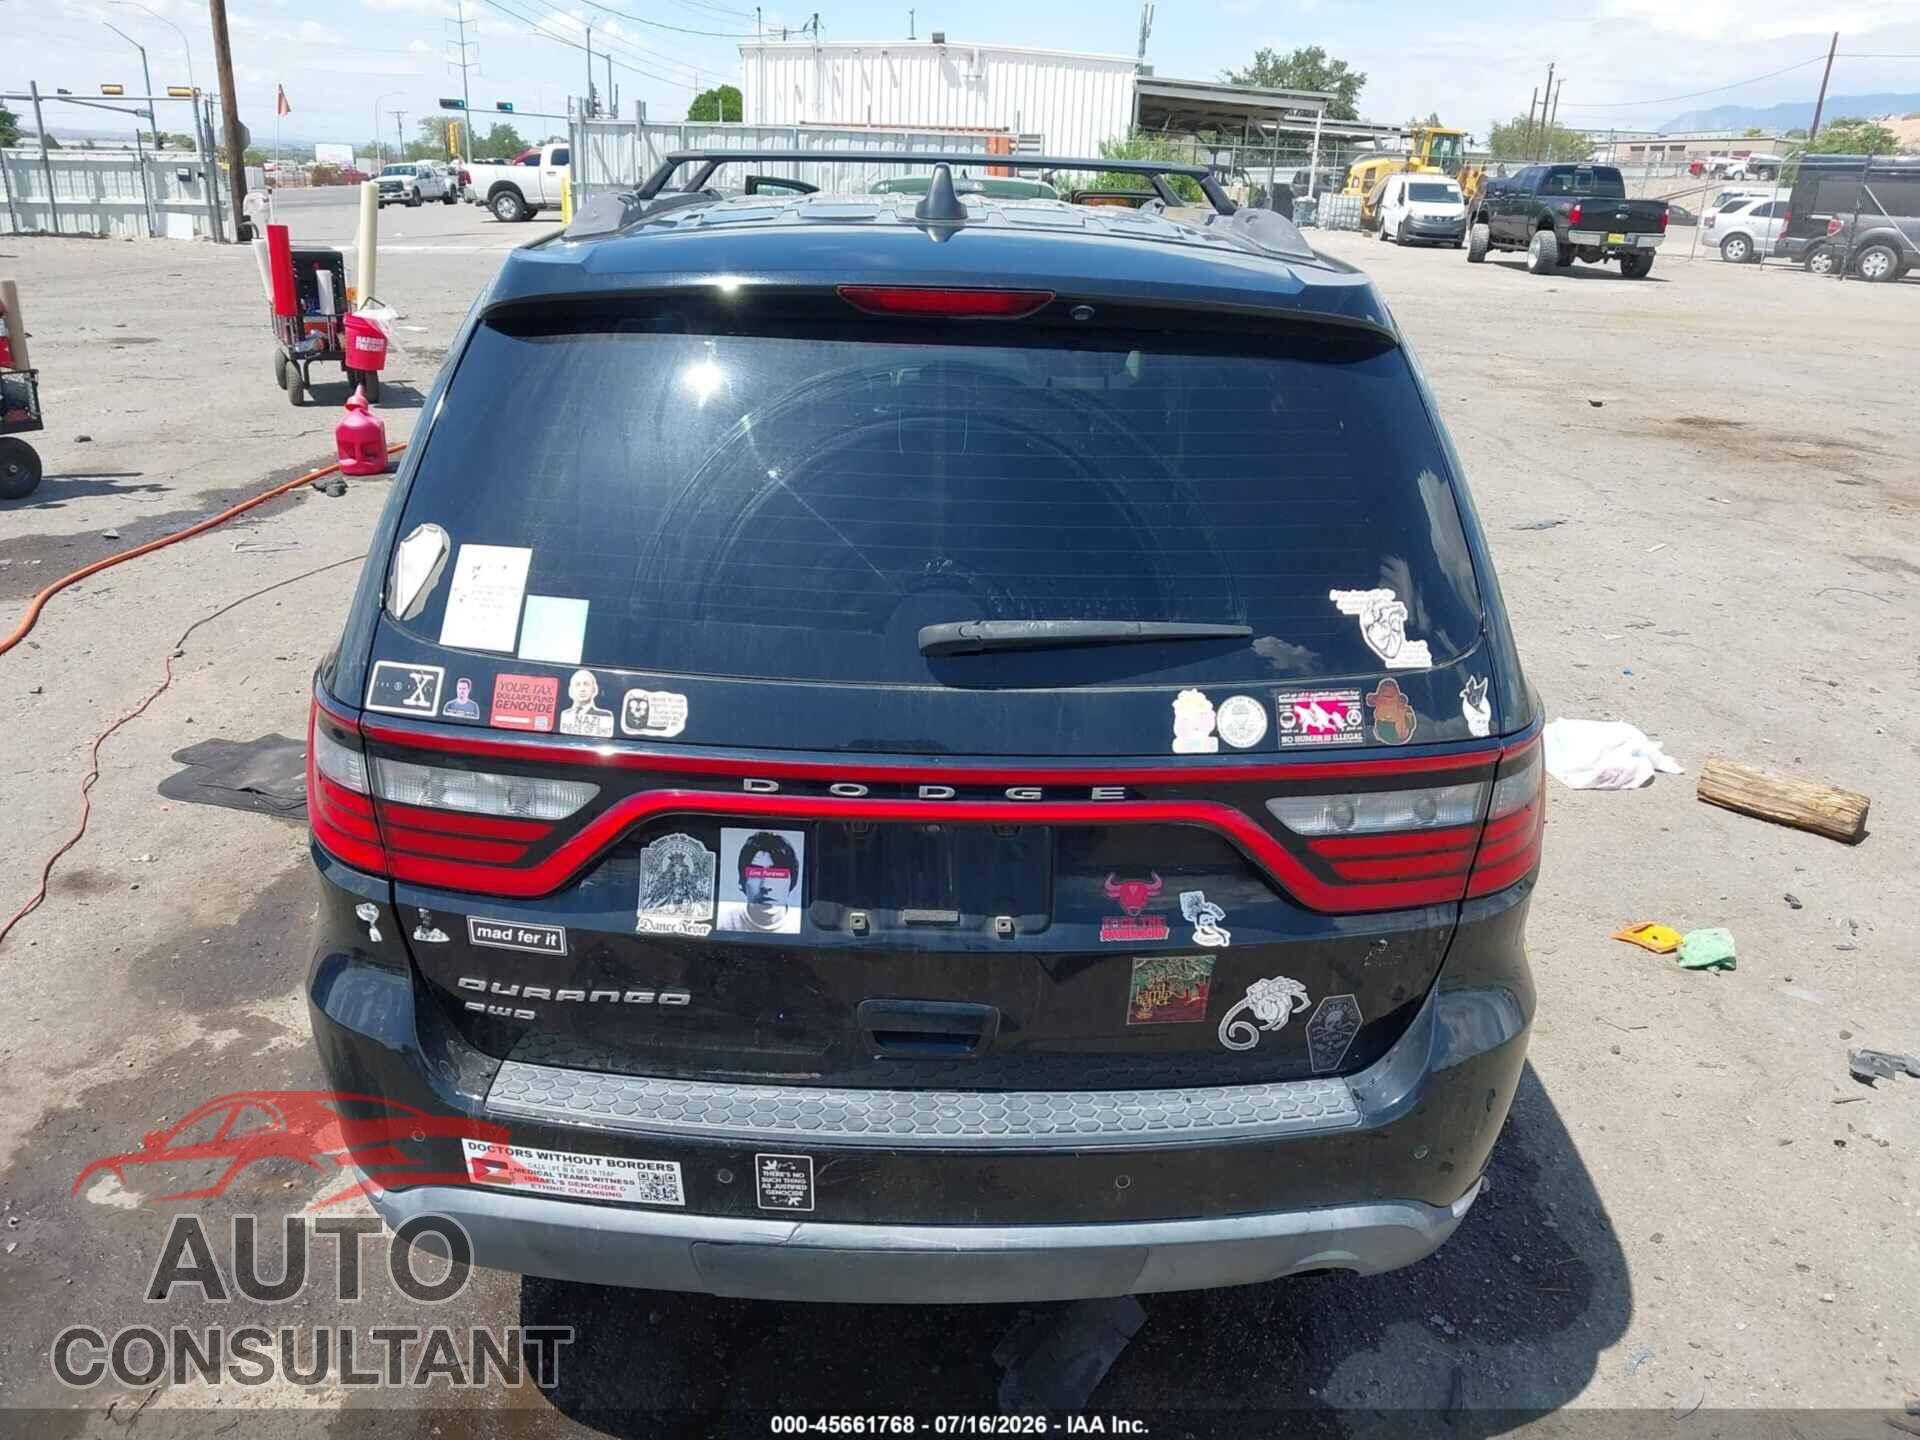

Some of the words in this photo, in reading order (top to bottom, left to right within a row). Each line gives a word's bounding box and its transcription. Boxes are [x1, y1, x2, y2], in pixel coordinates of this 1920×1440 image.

[498, 681, 529, 694] YOUR
[533, 684, 553, 696] TAX
[496, 692, 532, 701] DOLLARS
[533, 695, 554, 703] FUND
[495, 700, 554, 713] GENOCIDE
[1281, 736, 1294, 744] NO
[1333, 732, 1363, 742] ILLEGAL
[743, 778, 1126, 800] DODGE
[476, 925, 513, 941] mad
[517, 928, 541, 944] fer
[545, 932, 557, 947] it
[457, 976, 692, 1006] DURANGO
[464, 1001, 537, 1020] AWD
[467, 1141, 533, 1159] DOCTORS
[536, 1151, 602, 1167] WITHOUT
[606, 1159, 675, 1172] BORDERS
[513, 1167, 555, 1178] MEDICAL
[558, 1173, 590, 1182] TEAMS
[591, 1176, 635, 1186] WITNESS
[524, 1176, 565, 1186] ISRAEL'S
[568, 1181, 617, 1192] GENOCIDE
[531, 1183, 565, 1193] ETHNIC
[567, 1187, 624, 1199] CLEANSING
[765, 1189, 804, 1197] GENOCIDE
